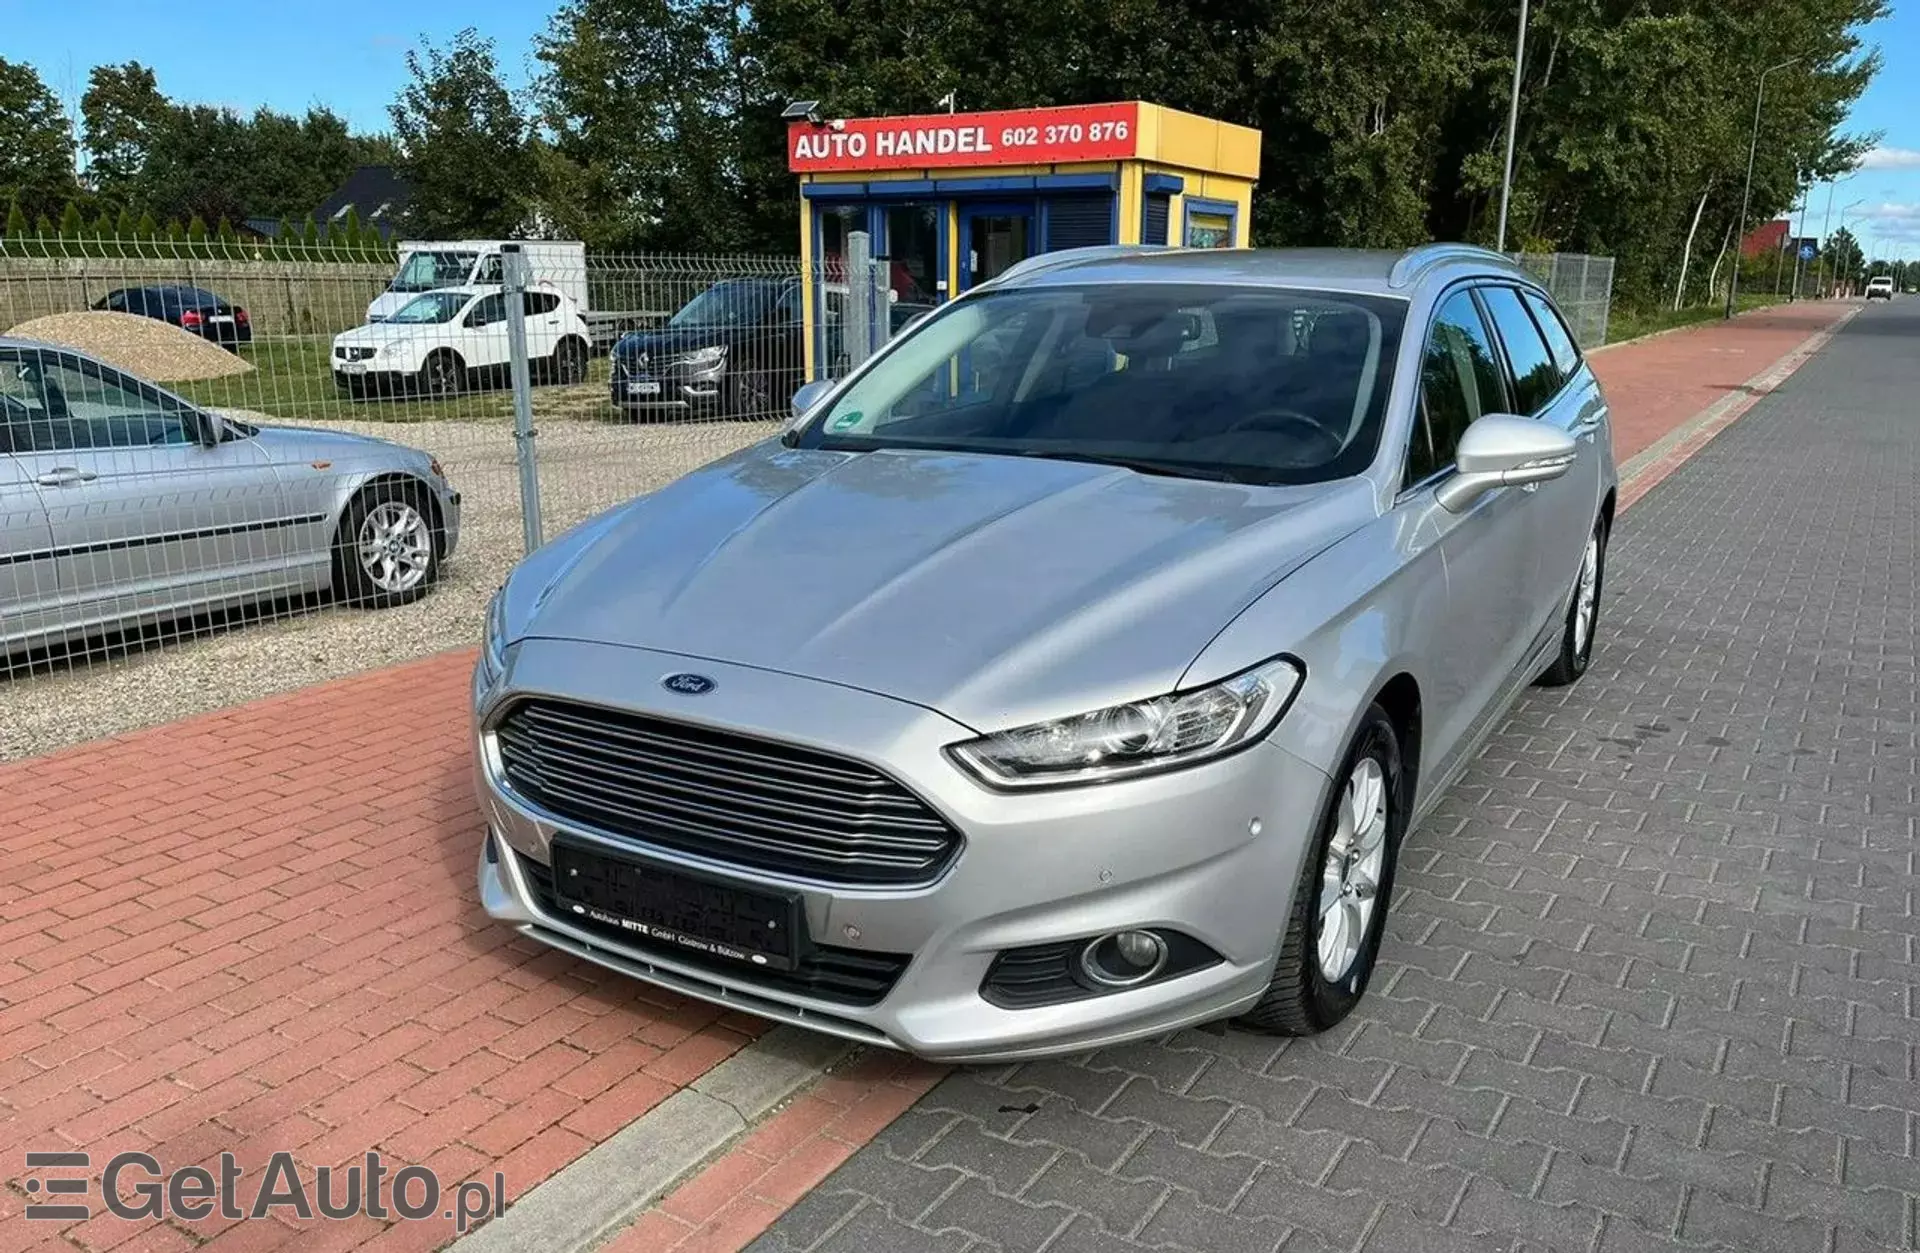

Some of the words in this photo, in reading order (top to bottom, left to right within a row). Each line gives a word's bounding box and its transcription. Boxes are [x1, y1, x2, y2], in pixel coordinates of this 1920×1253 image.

[795, 133, 866, 158] AUTO
[876, 126, 993, 156] HANDEL
[1001, 128, 1038, 146] 602
[1044, 124, 1082, 143] 370
[1088, 121, 1128, 141] 876
[673, 676, 705, 691] Ford
[622, 918, 649, 935] MITTE
